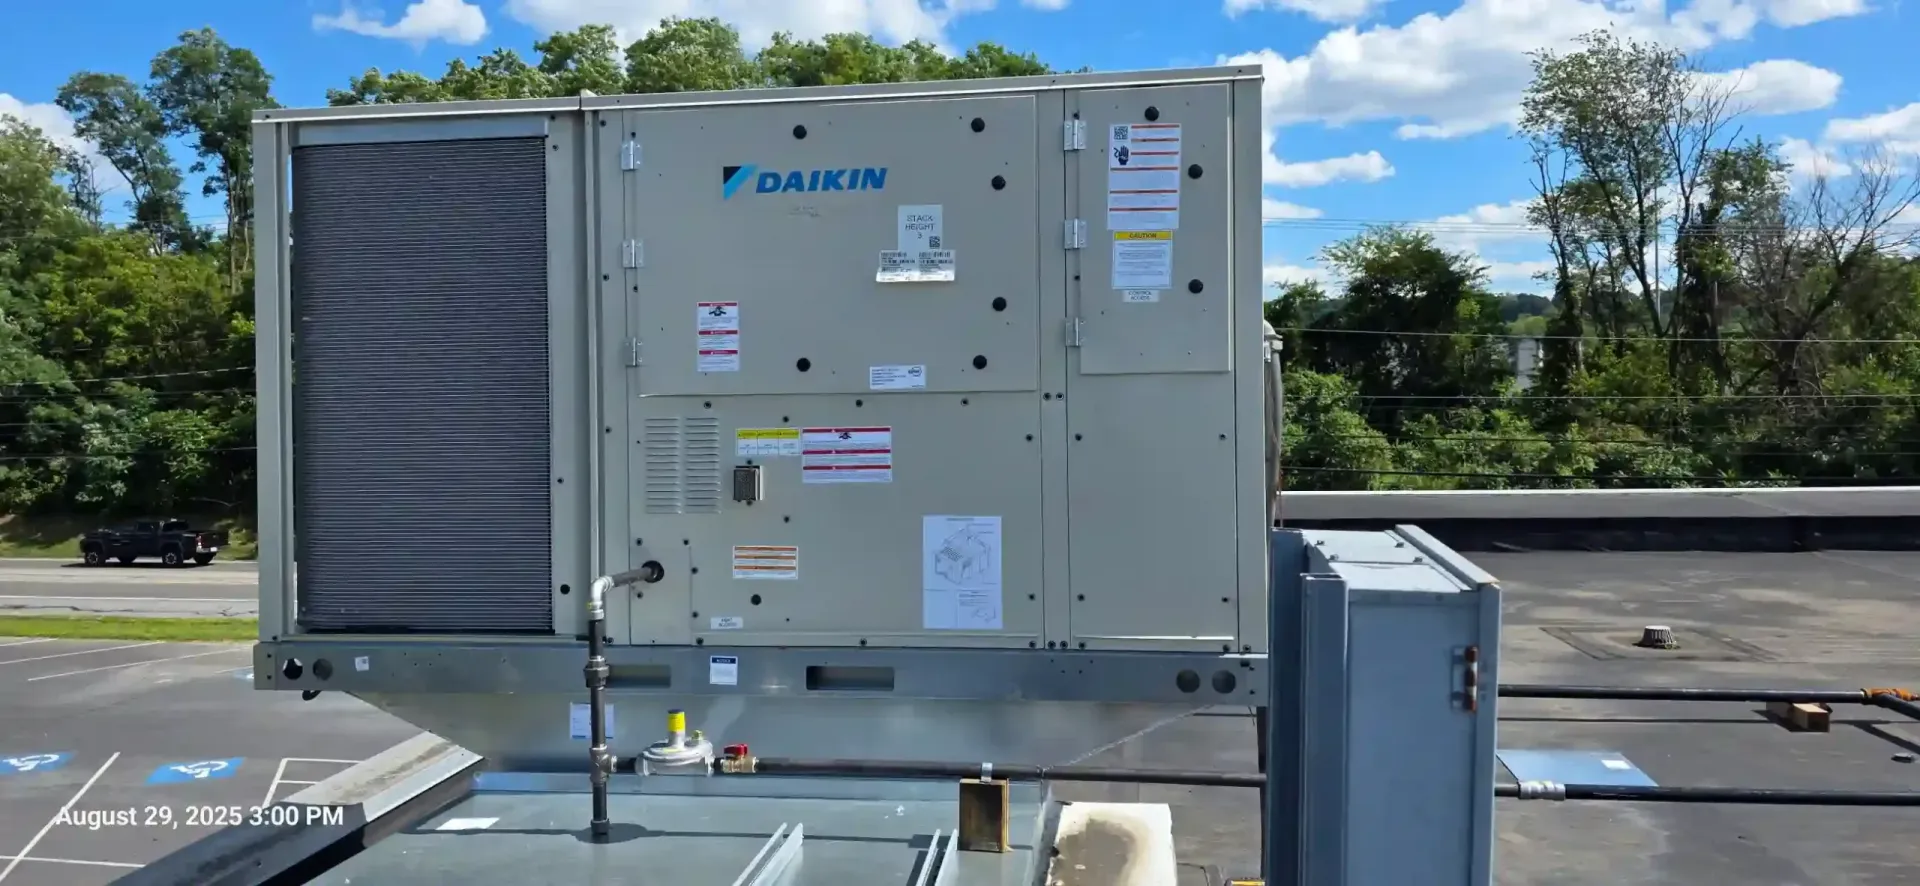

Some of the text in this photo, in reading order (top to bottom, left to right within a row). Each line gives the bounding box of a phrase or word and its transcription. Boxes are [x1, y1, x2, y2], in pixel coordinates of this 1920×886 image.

[756, 168, 888, 193] DAIKIN
[906, 214, 934, 222] STACK
[905, 223, 935, 231] HEIGHT
[917, 231, 923, 240] 3
